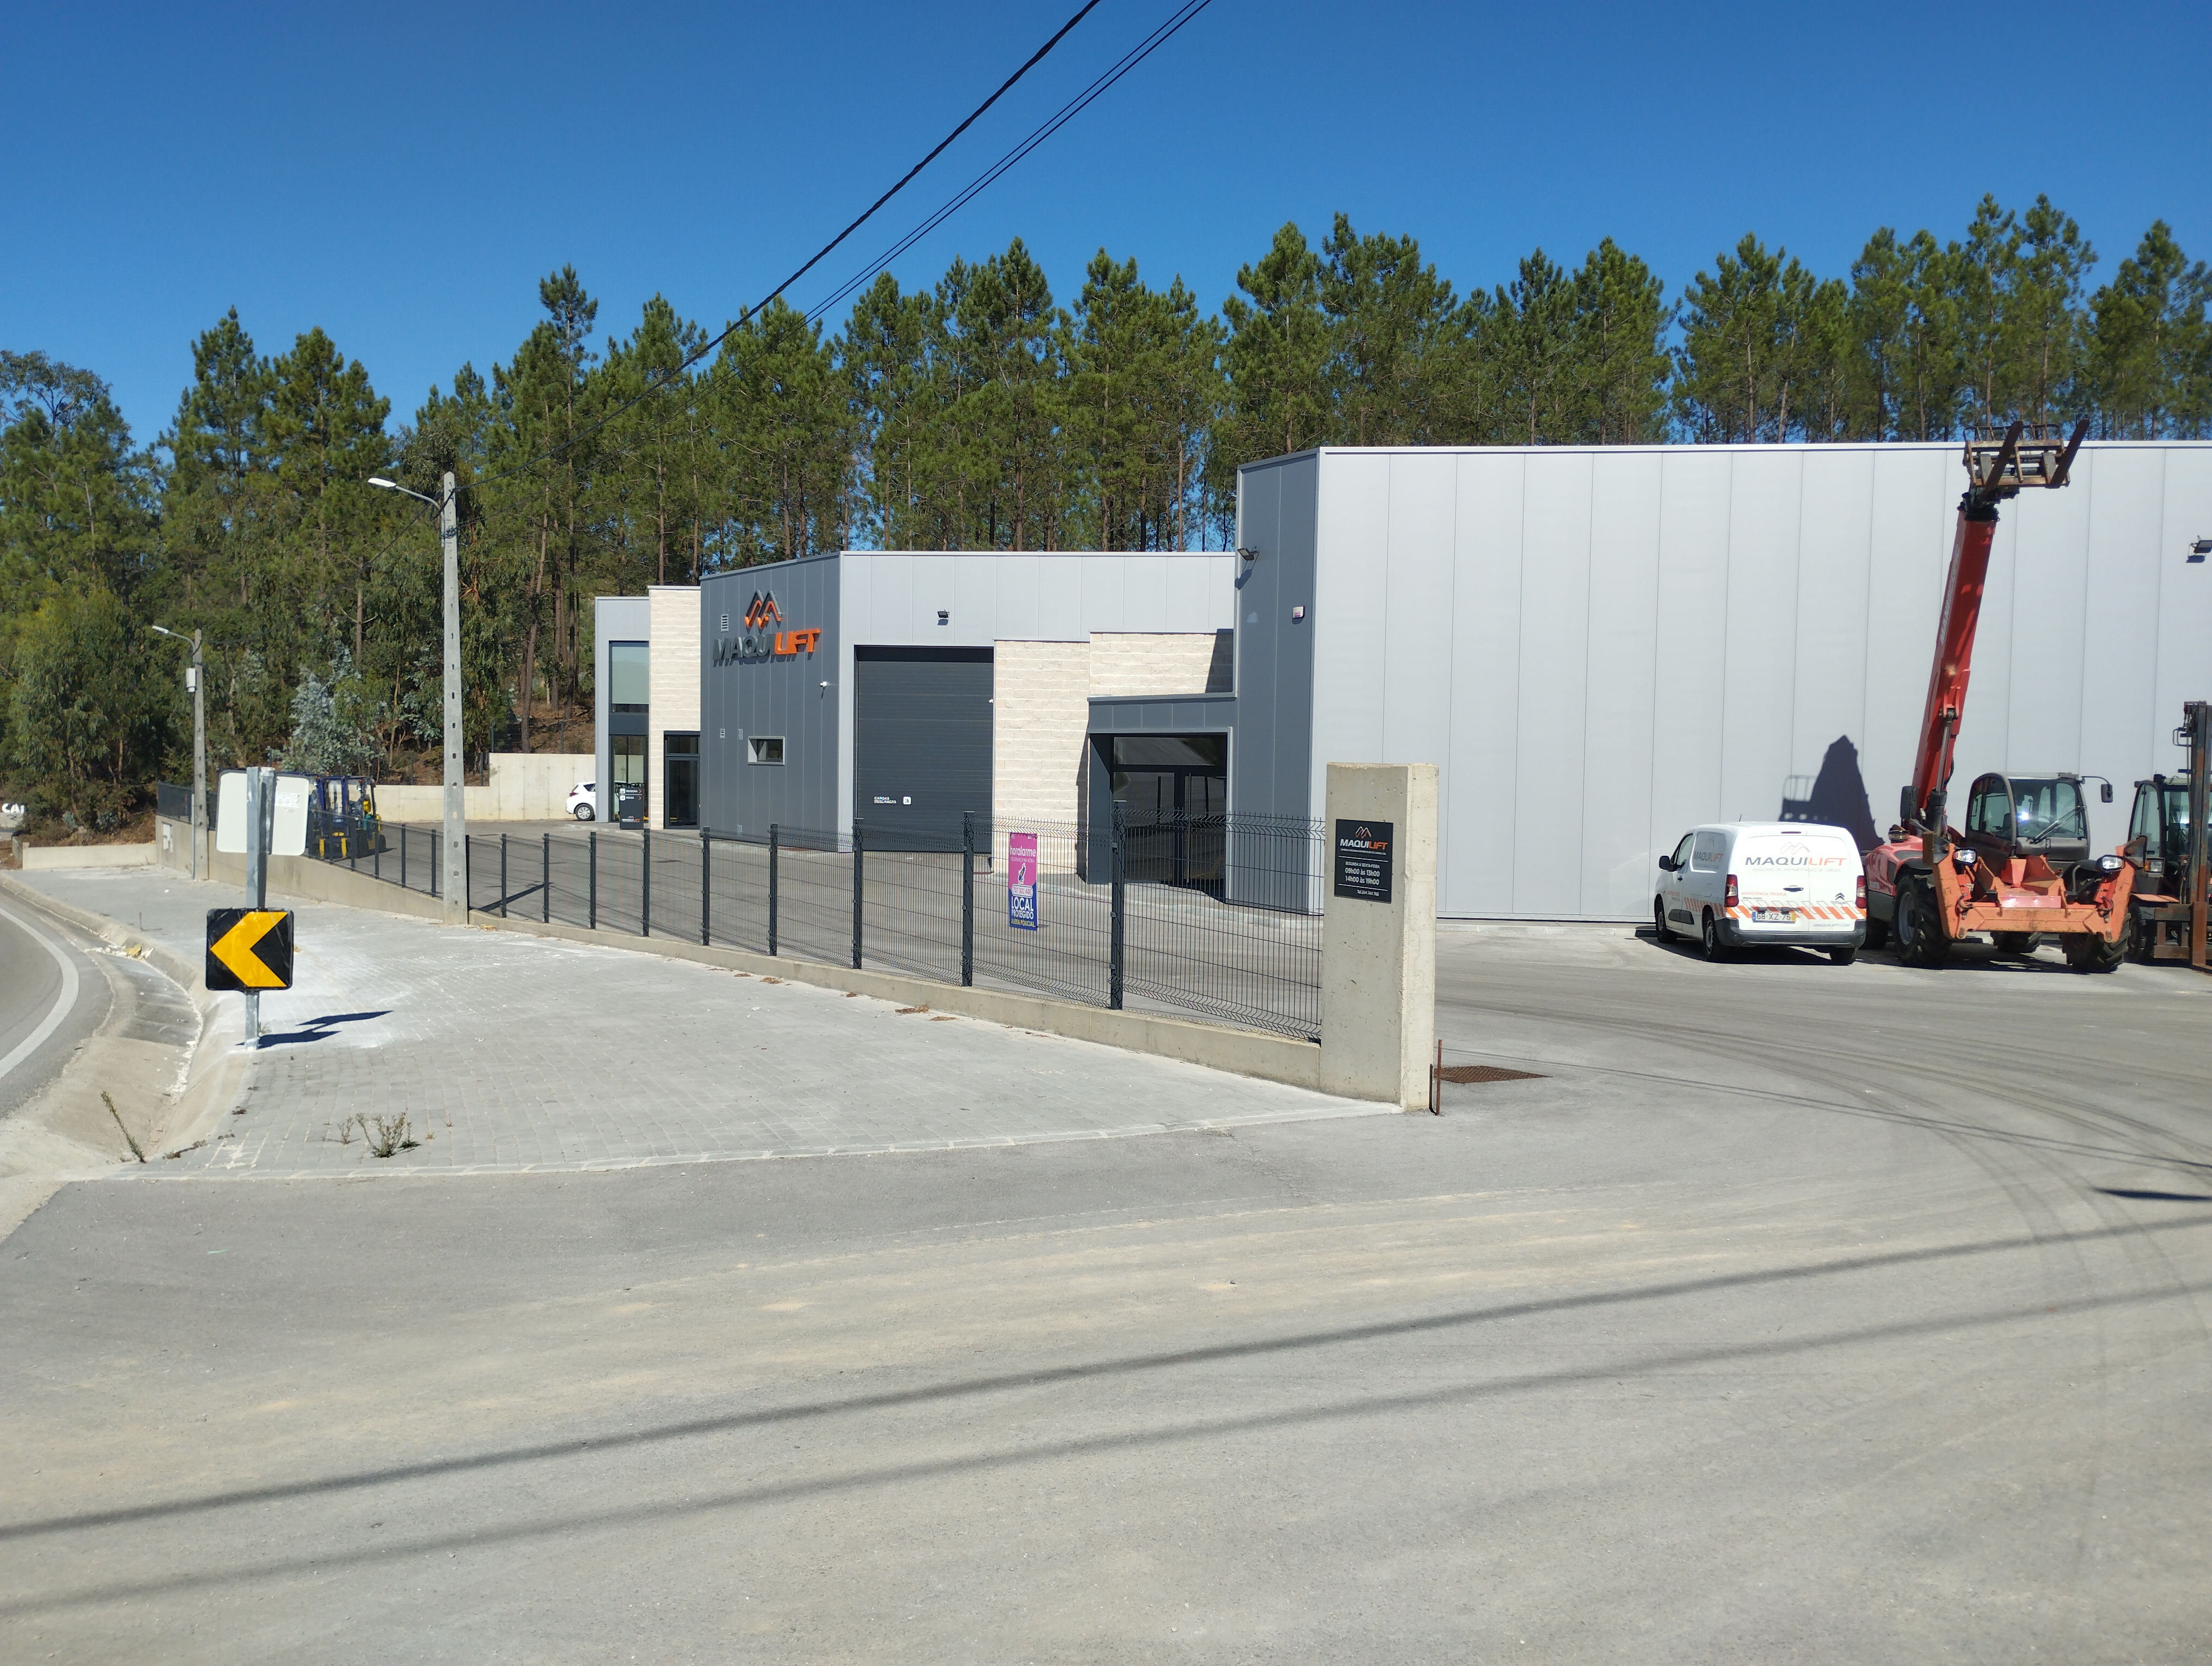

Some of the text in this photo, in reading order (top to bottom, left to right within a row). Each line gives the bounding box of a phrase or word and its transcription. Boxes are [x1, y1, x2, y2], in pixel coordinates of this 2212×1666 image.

[712, 628, 821, 660] MAQUILIFT
[1340, 839, 1388, 850] MAQUILIFT
[1010, 845, 1036, 857] horalarme
[1694, 851, 1724, 863] MAQUILIFT
[1745, 857, 1847, 866] MAQUILIFT
[1012, 896, 1033, 911] LOCAL
[1012, 909, 1033, 919] PROTEGIDO
